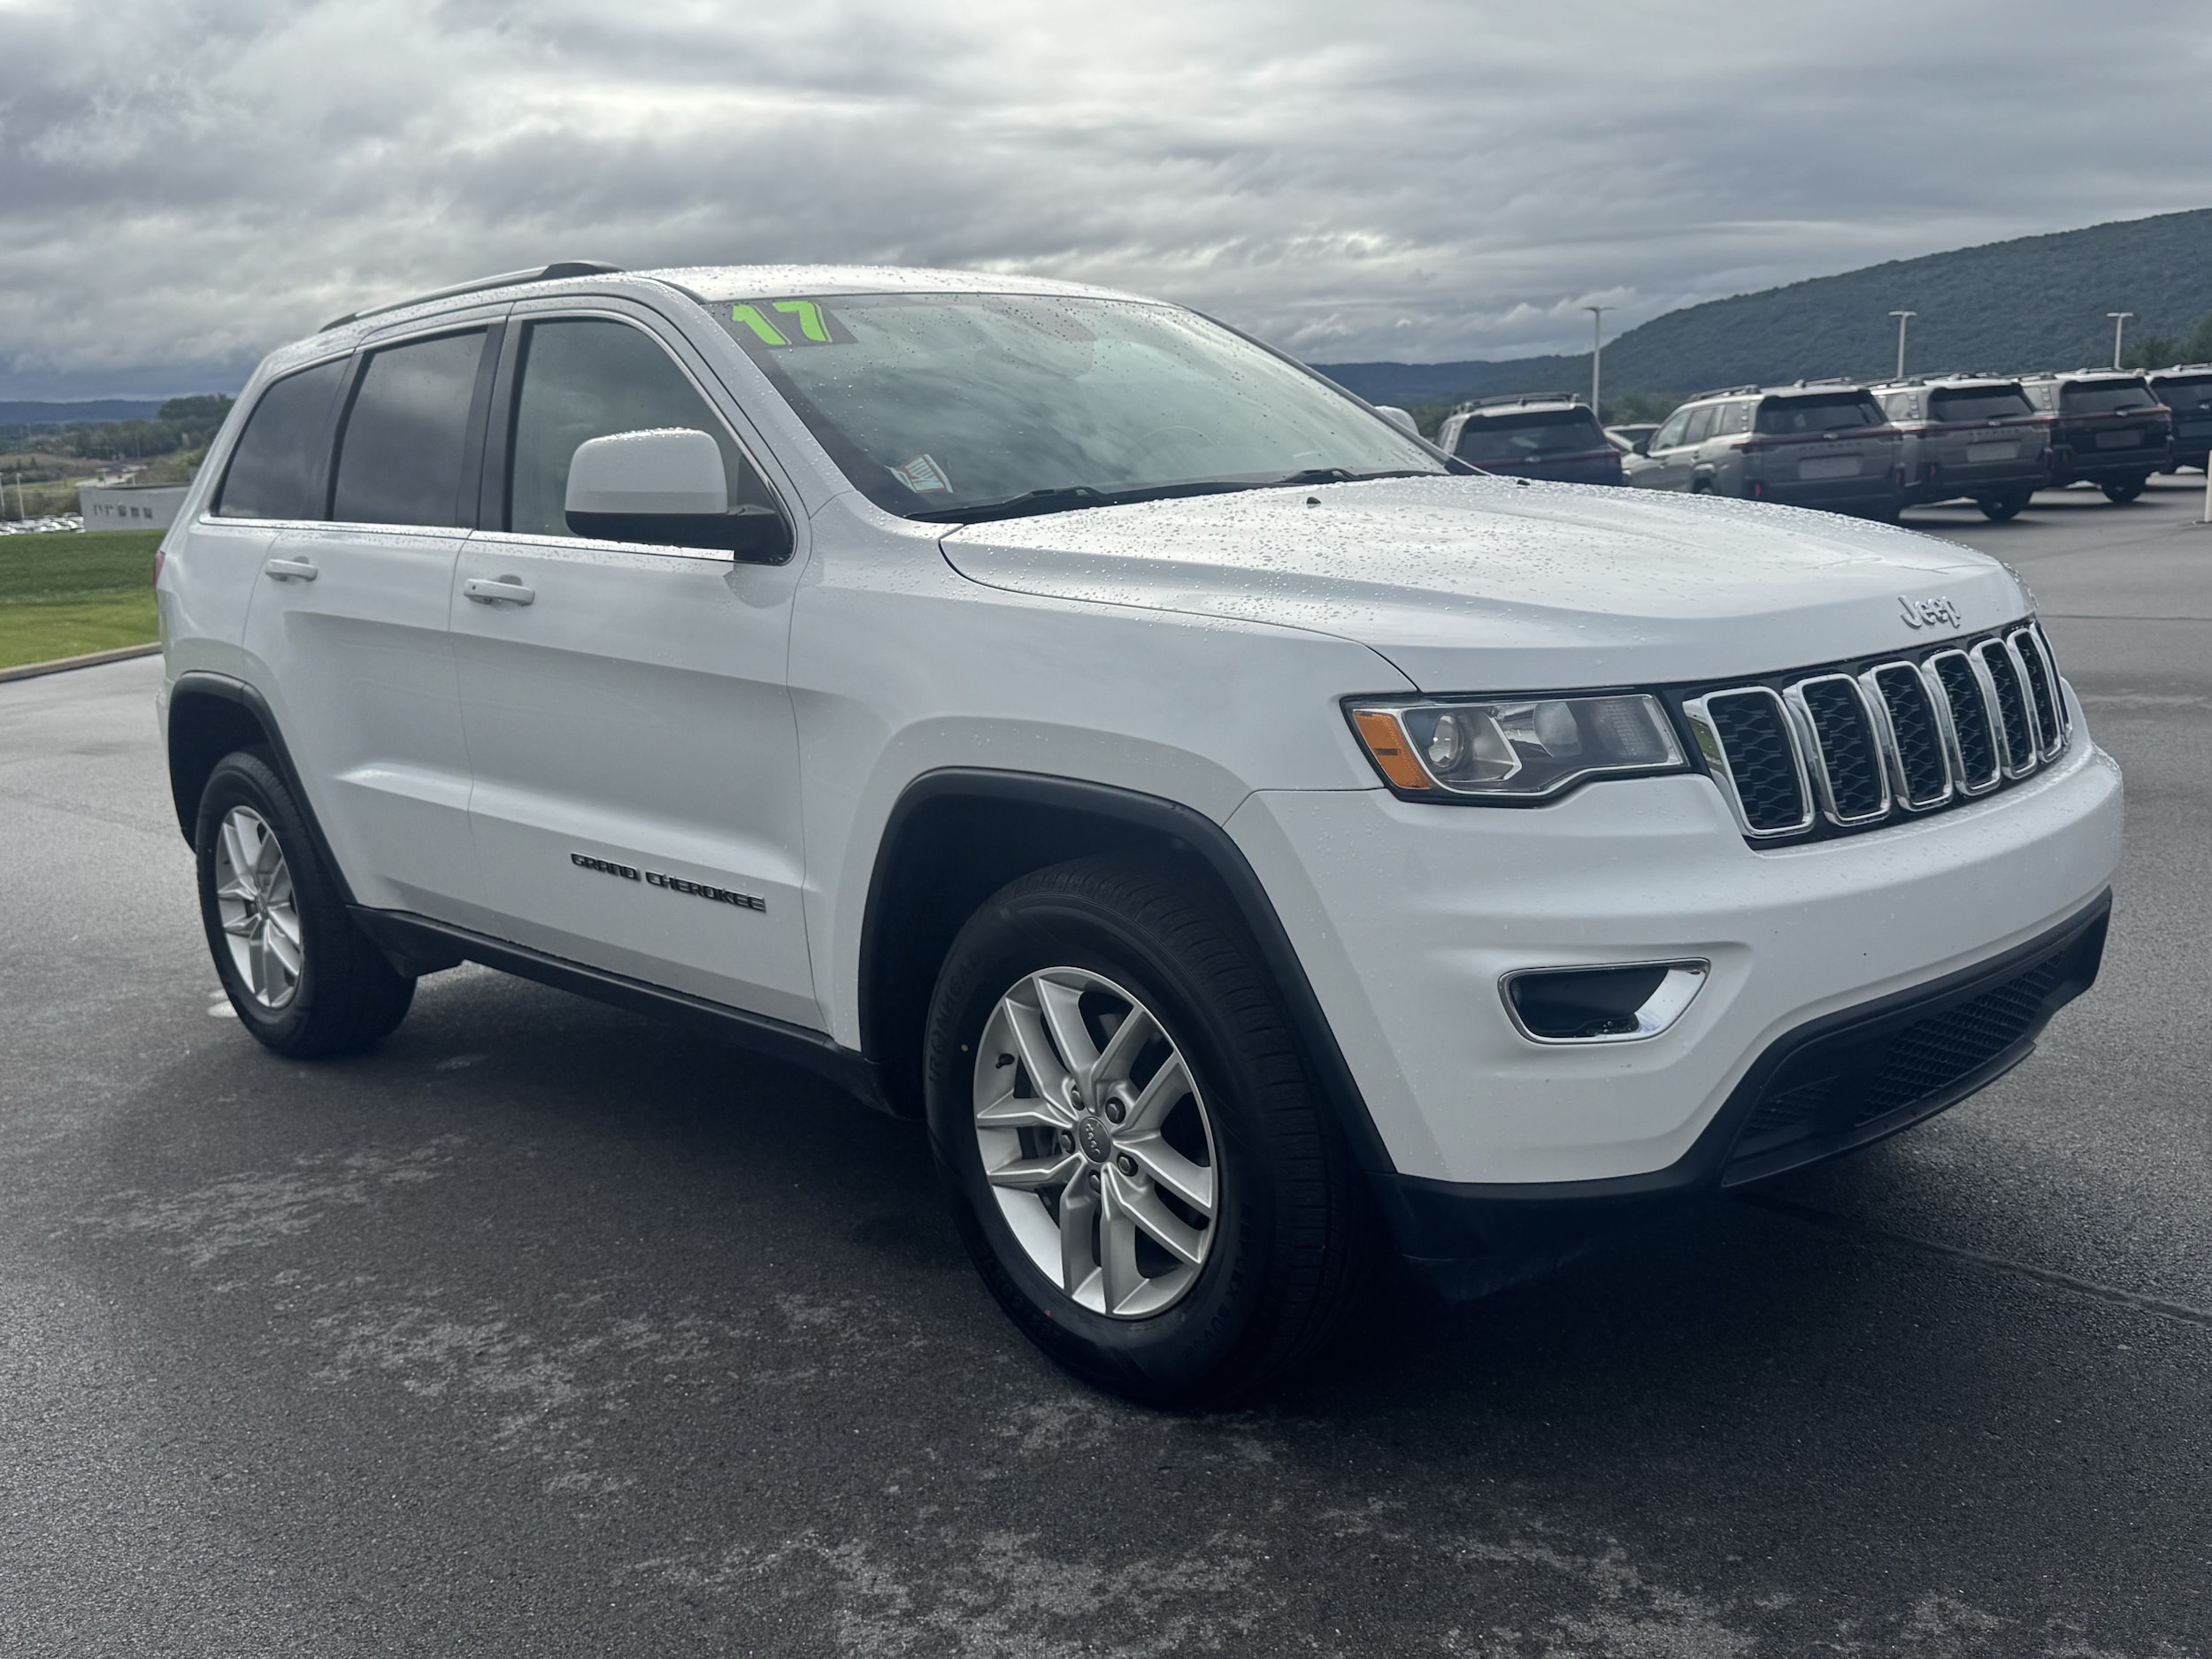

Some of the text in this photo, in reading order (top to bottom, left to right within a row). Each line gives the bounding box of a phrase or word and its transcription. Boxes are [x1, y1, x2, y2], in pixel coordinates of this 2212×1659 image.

[732, 300, 833, 345] 17
[1898, 595, 1961, 630] Jeep
[571, 851, 767, 912] GRAND CHEROKEE
